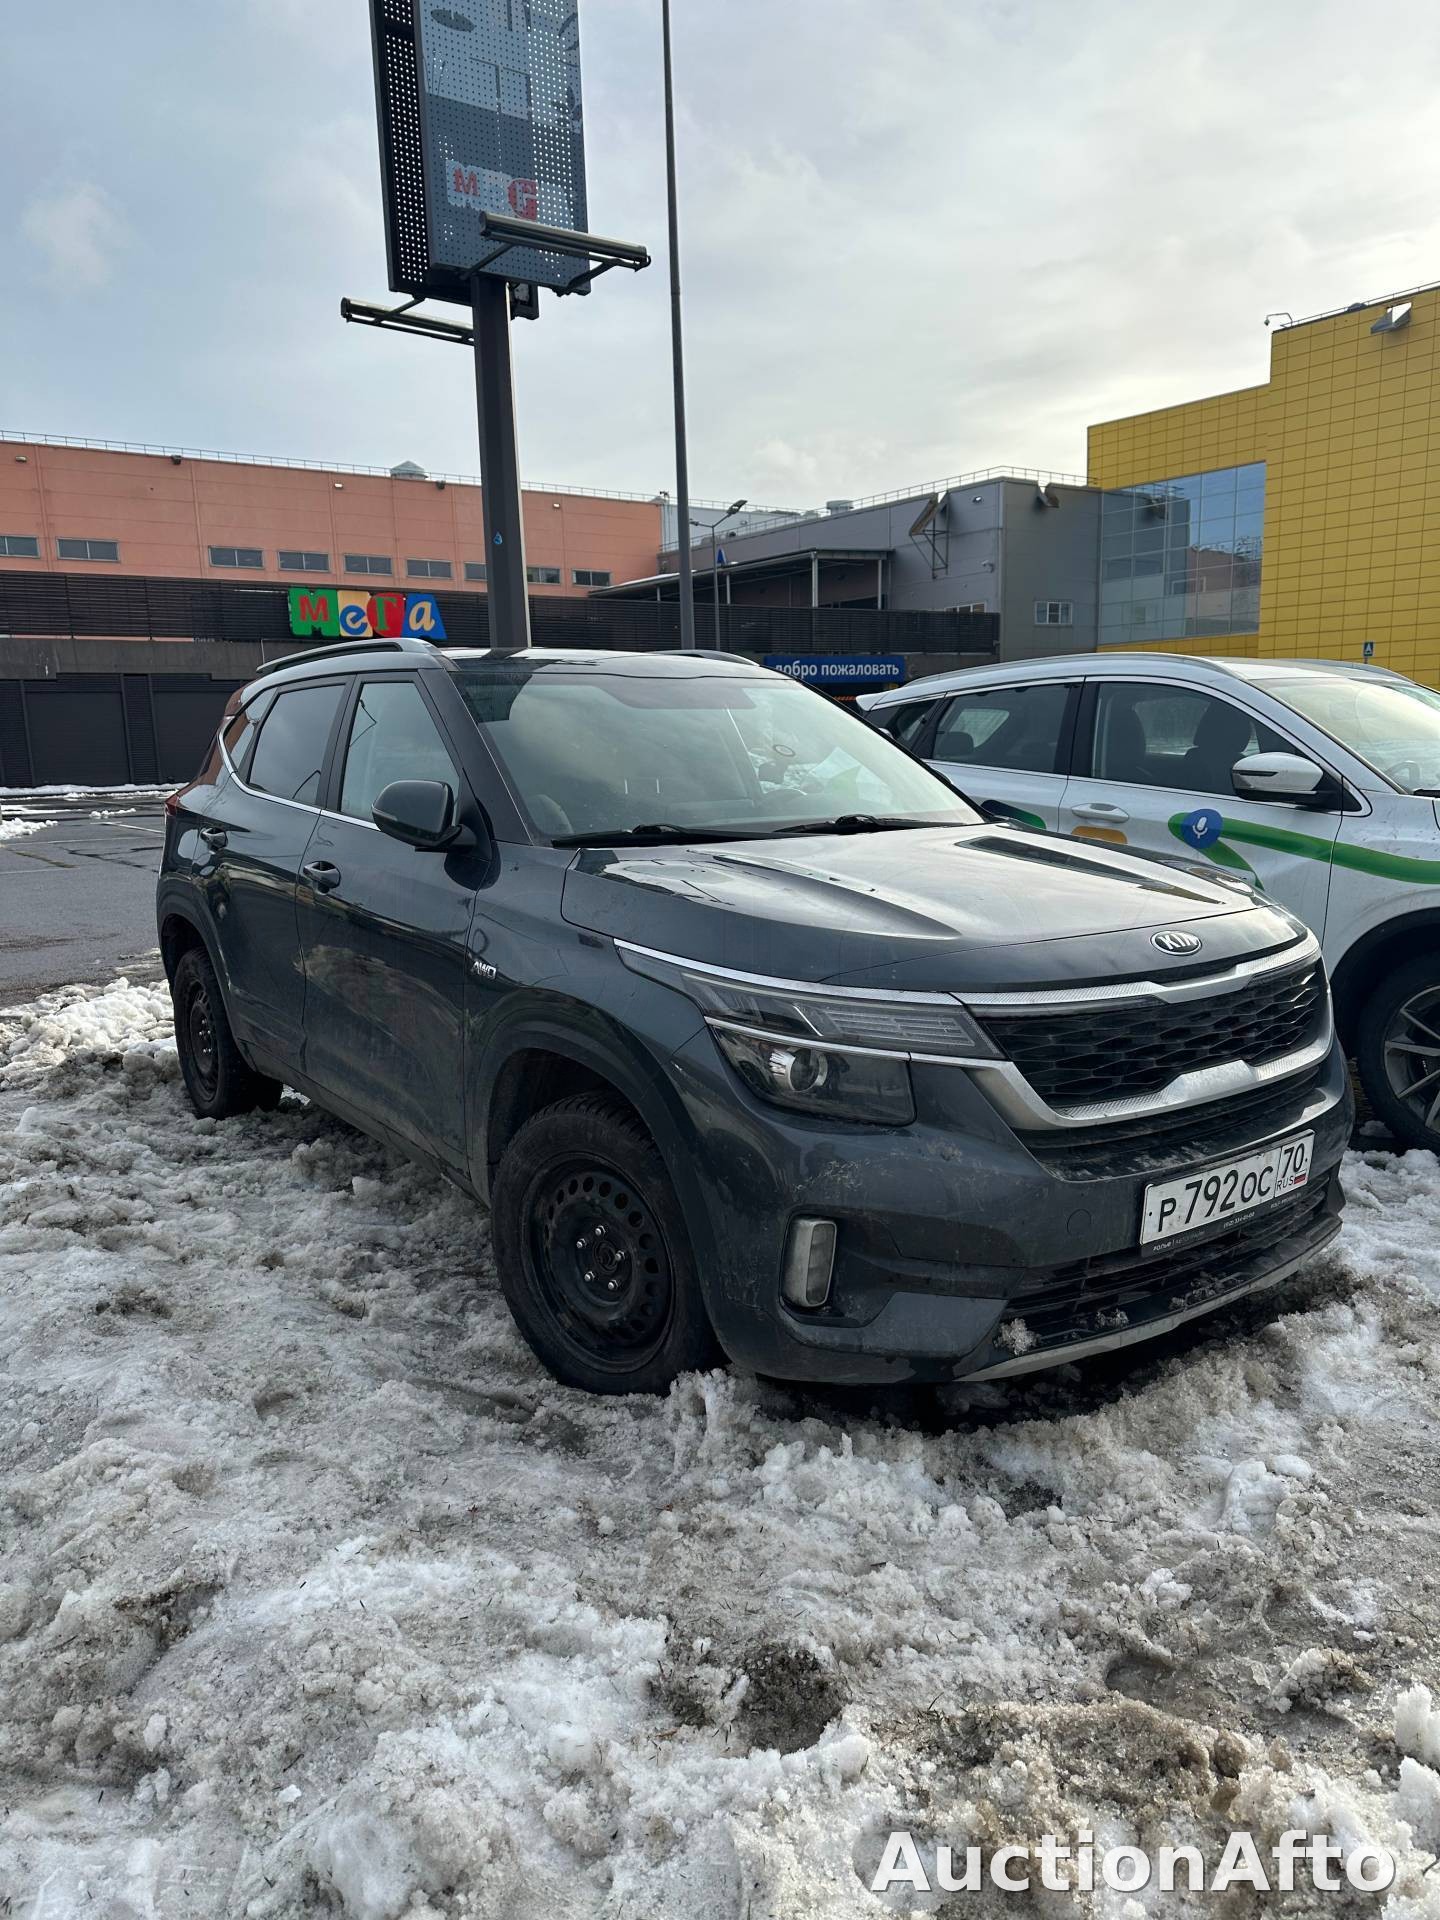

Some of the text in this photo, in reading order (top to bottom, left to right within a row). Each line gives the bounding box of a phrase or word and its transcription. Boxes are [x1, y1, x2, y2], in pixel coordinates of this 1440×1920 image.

[821, 663, 899, 676] пожаловать
[1157, 931, 1199, 951] KIA
[471, 960, 496, 980] AWD
[1282, 1143, 1305, 1179] 70
[1277, 1176, 1294, 1191] RUS
